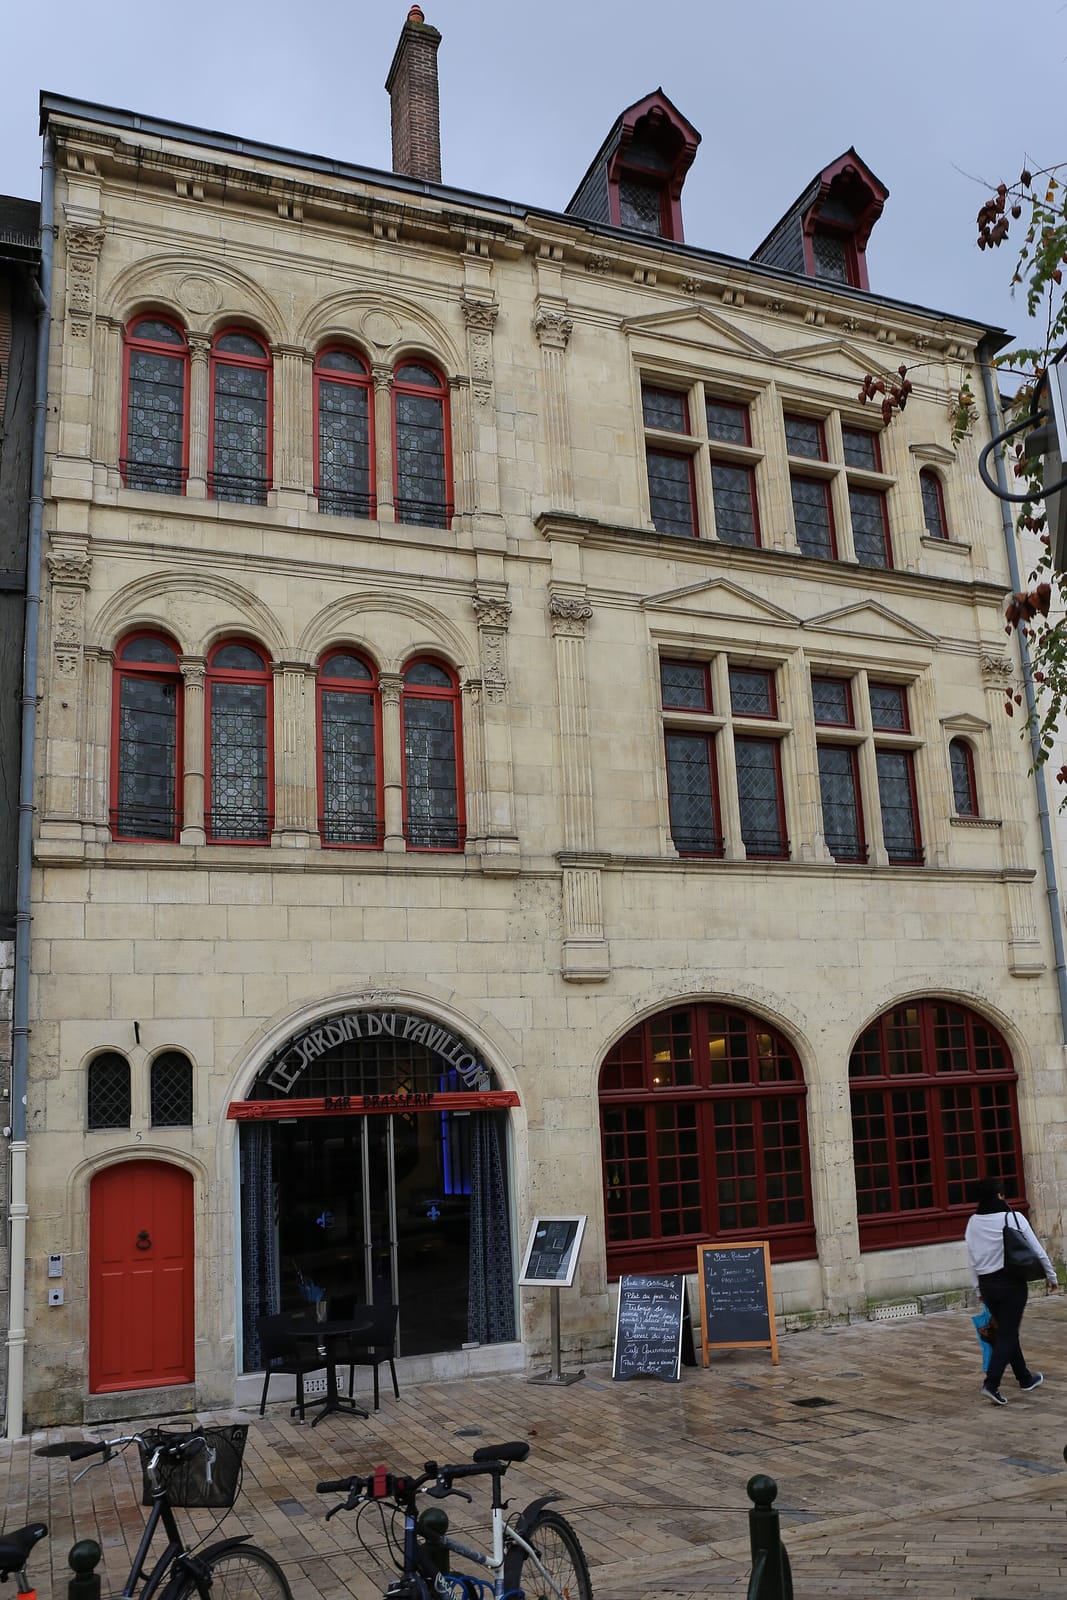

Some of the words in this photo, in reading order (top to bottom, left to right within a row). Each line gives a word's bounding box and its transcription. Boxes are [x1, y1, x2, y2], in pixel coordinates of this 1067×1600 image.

[267, 1061, 301, 1094] LE
[293, 1016, 363, 1070] JARDIN
[366, 1013, 395, 1037] DU
[402, 1016, 489, 1088] PAVILLON
[324, 1096, 351, 1110] BAR
[363, 1093, 434, 1109] BRASSERIE
[133, 1131, 142, 1143] 5
